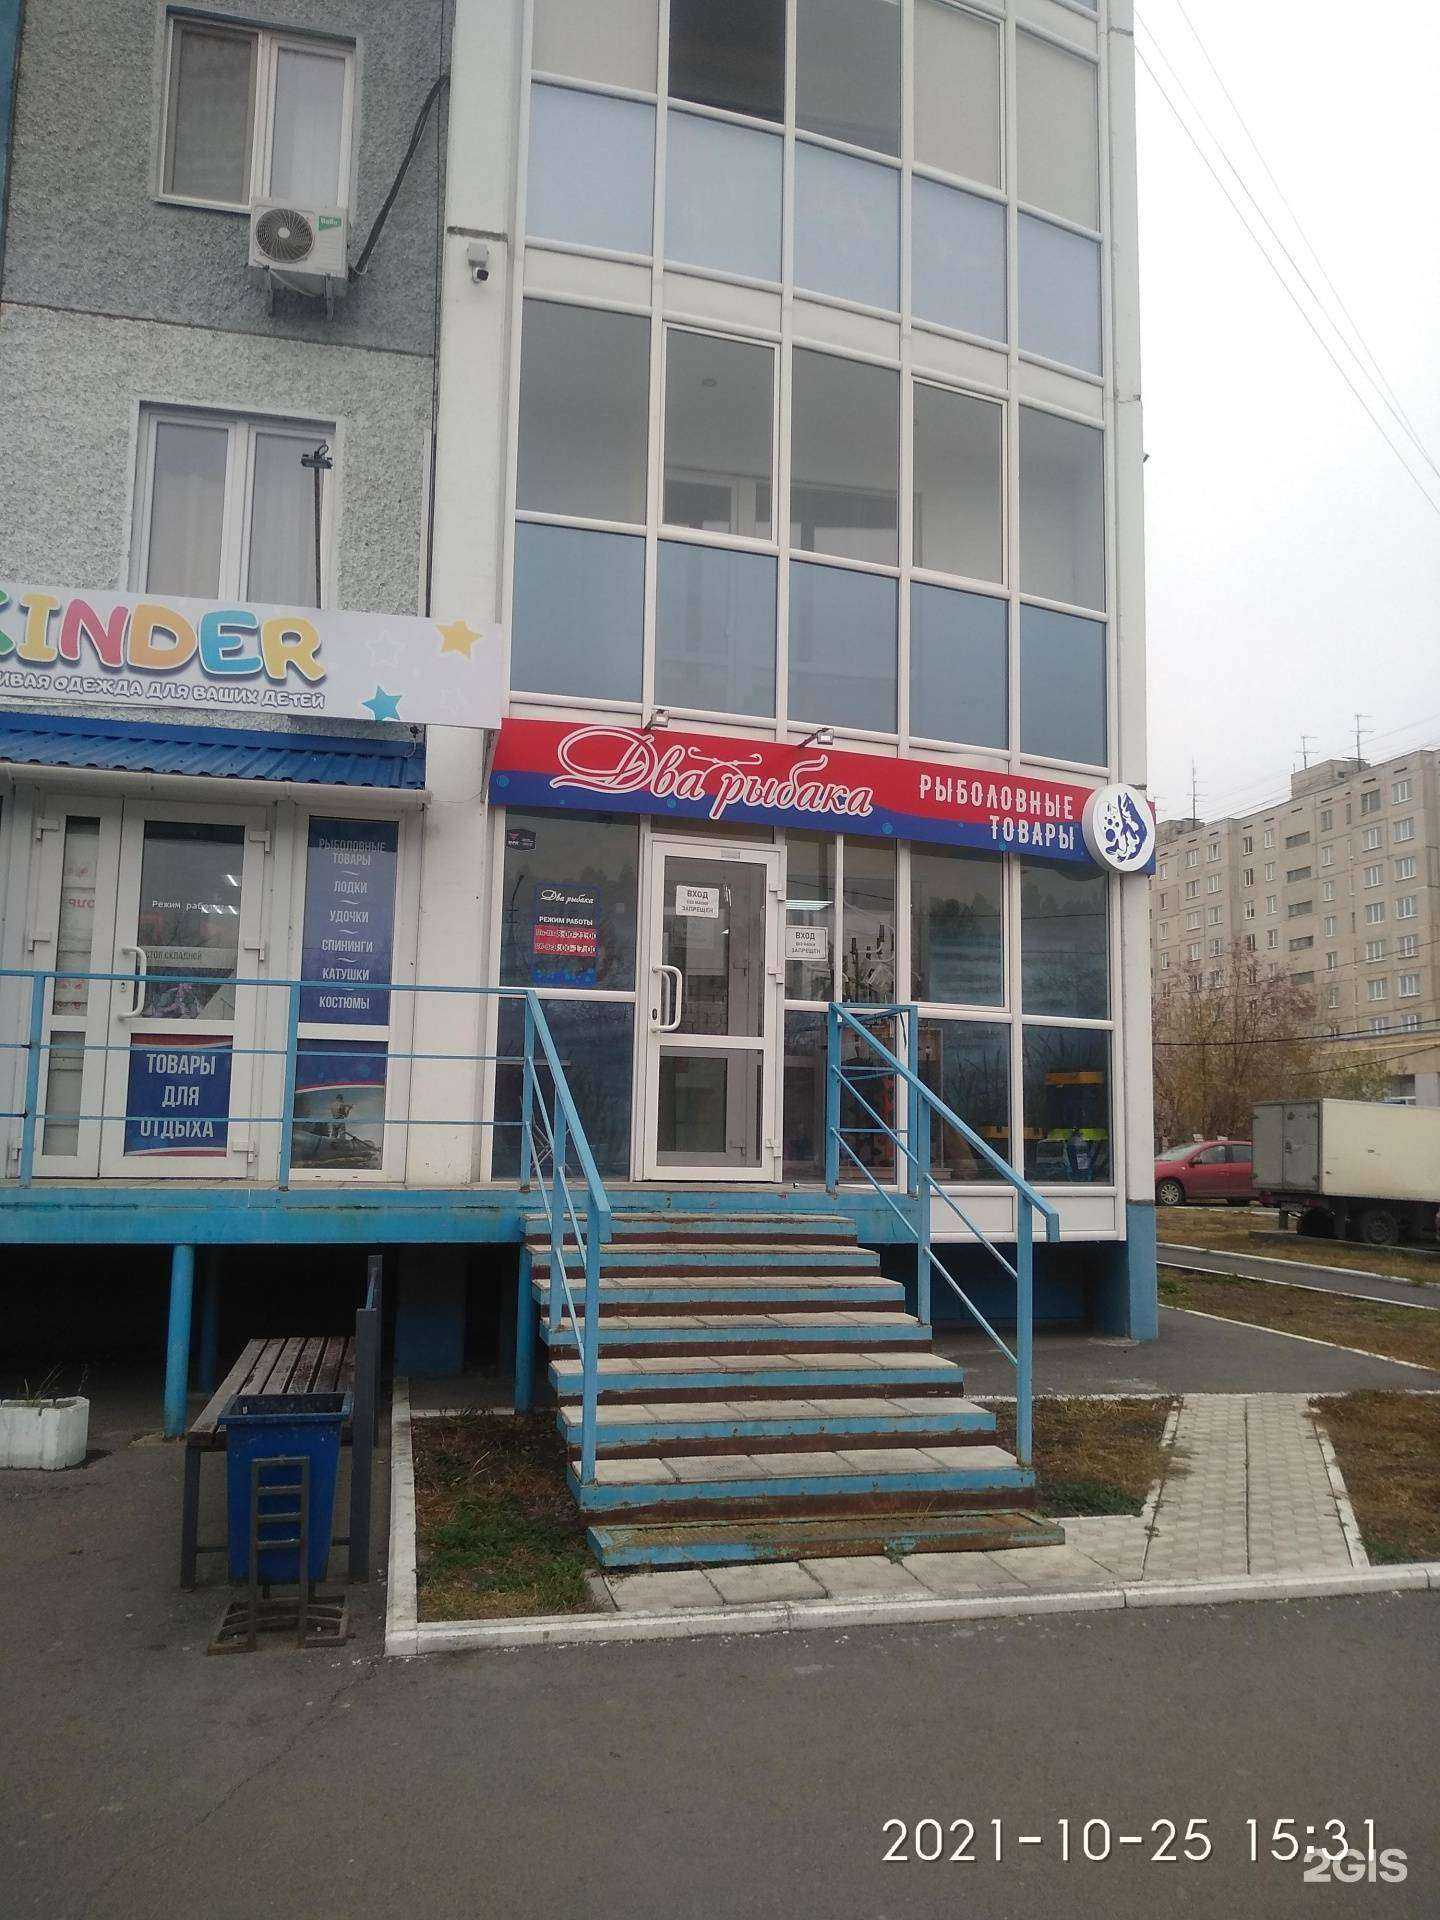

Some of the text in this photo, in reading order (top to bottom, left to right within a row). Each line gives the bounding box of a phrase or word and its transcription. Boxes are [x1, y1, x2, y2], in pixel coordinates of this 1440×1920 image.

[54, 676, 142, 697] ОДЕЖДА
[146, 681, 190, 700] ДЛЯ
[192, 686, 258, 704] ВАШИХ
[261, 689, 325, 709] ДЕТЕЙ
[549, 725, 874, 820] Два рыбака
[919, 774, 1074, 820] РЫБОЛОВНЫЕ
[989, 815, 1075, 850] ТОВАРЫ
[332, 853, 371, 866] ТОВАРЫ
[334, 880, 368, 894] ЛОДКИ
[540, 889, 595, 905] Два рыбака
[687, 890, 709, 900] ВХОД
[329, 910, 369, 924] УДОЧКИ
[538, 916, 593, 926] РЕЖИМ РАБОТЫ
[795, 931, 816, 941] ВХОД
[321, 939, 374, 953] СПИНИНГИ
[322, 967, 370, 981] КАТУШКИ
[319, 996, 370, 1010] КОСТЮМЫ
[146, 1053, 216, 1075] ТОВАРЫ
[161, 1085, 200, 1108] ДЛЯ
